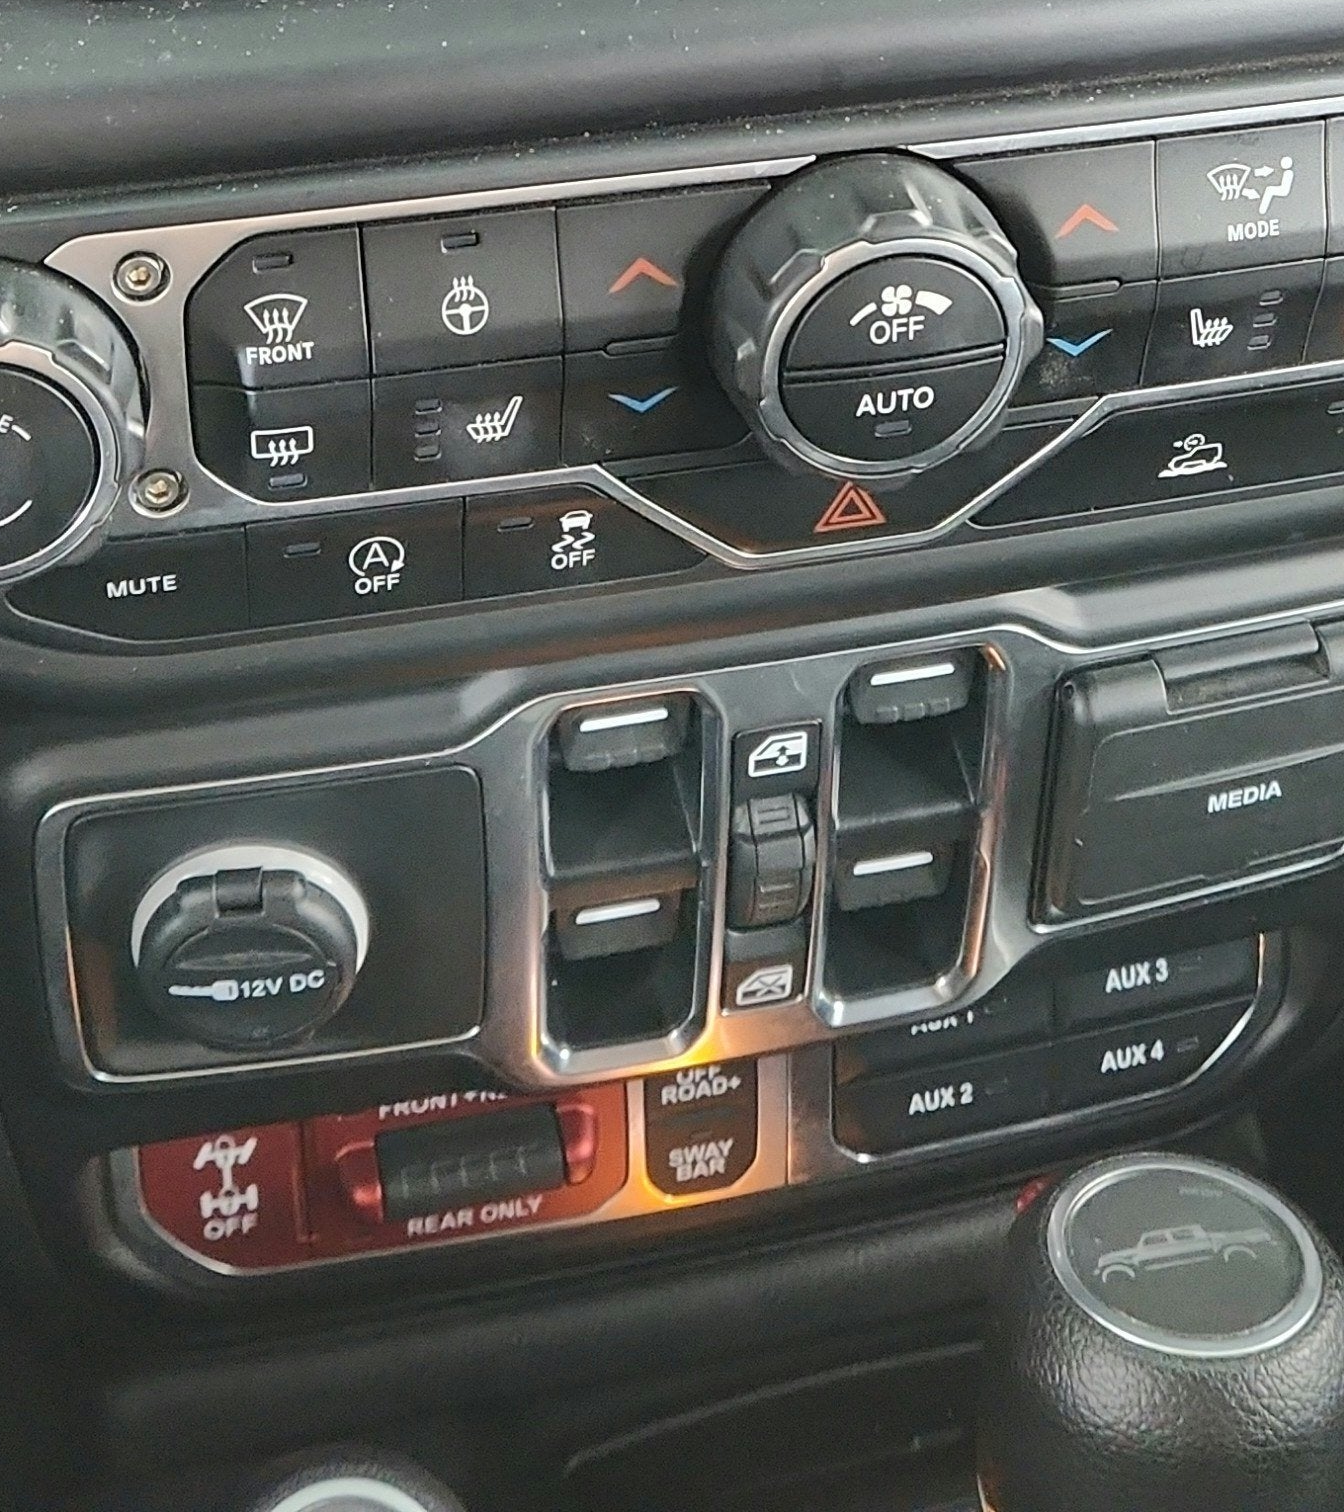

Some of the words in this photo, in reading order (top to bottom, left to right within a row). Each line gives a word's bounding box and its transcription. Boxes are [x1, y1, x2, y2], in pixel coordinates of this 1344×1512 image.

[1227, 218, 1280, 242] MODE
[869, 315, 926, 345] OFF
[244, 340, 315, 367] FRONT
[855, 385, 935, 417] AUTO
[550, 545, 596, 570] OFF
[106, 574, 178, 599] MUTE
[354, 572, 401, 595] OFF
[1207, 780, 1282, 813] MEDIA
[239, 976, 283, 999] 12V
[289, 969, 325, 993] DC
[1106, 963, 1152, 994] AUX
[1155, 957, 1169, 982] 3
[1101, 1045, 1147, 1074] AUX
[1150, 1039, 1165, 1061] 4
[909, 1085, 956, 1115] AUX
[960, 1081, 973, 1104] 2
[668, 1138, 734, 1168] SWAY
[676, 1157, 725, 1182] BAR
[202, 1210, 258, 1240] OFF
[407, 1207, 472, 1237] REAR
[479, 1193, 544, 1224] ONLY
